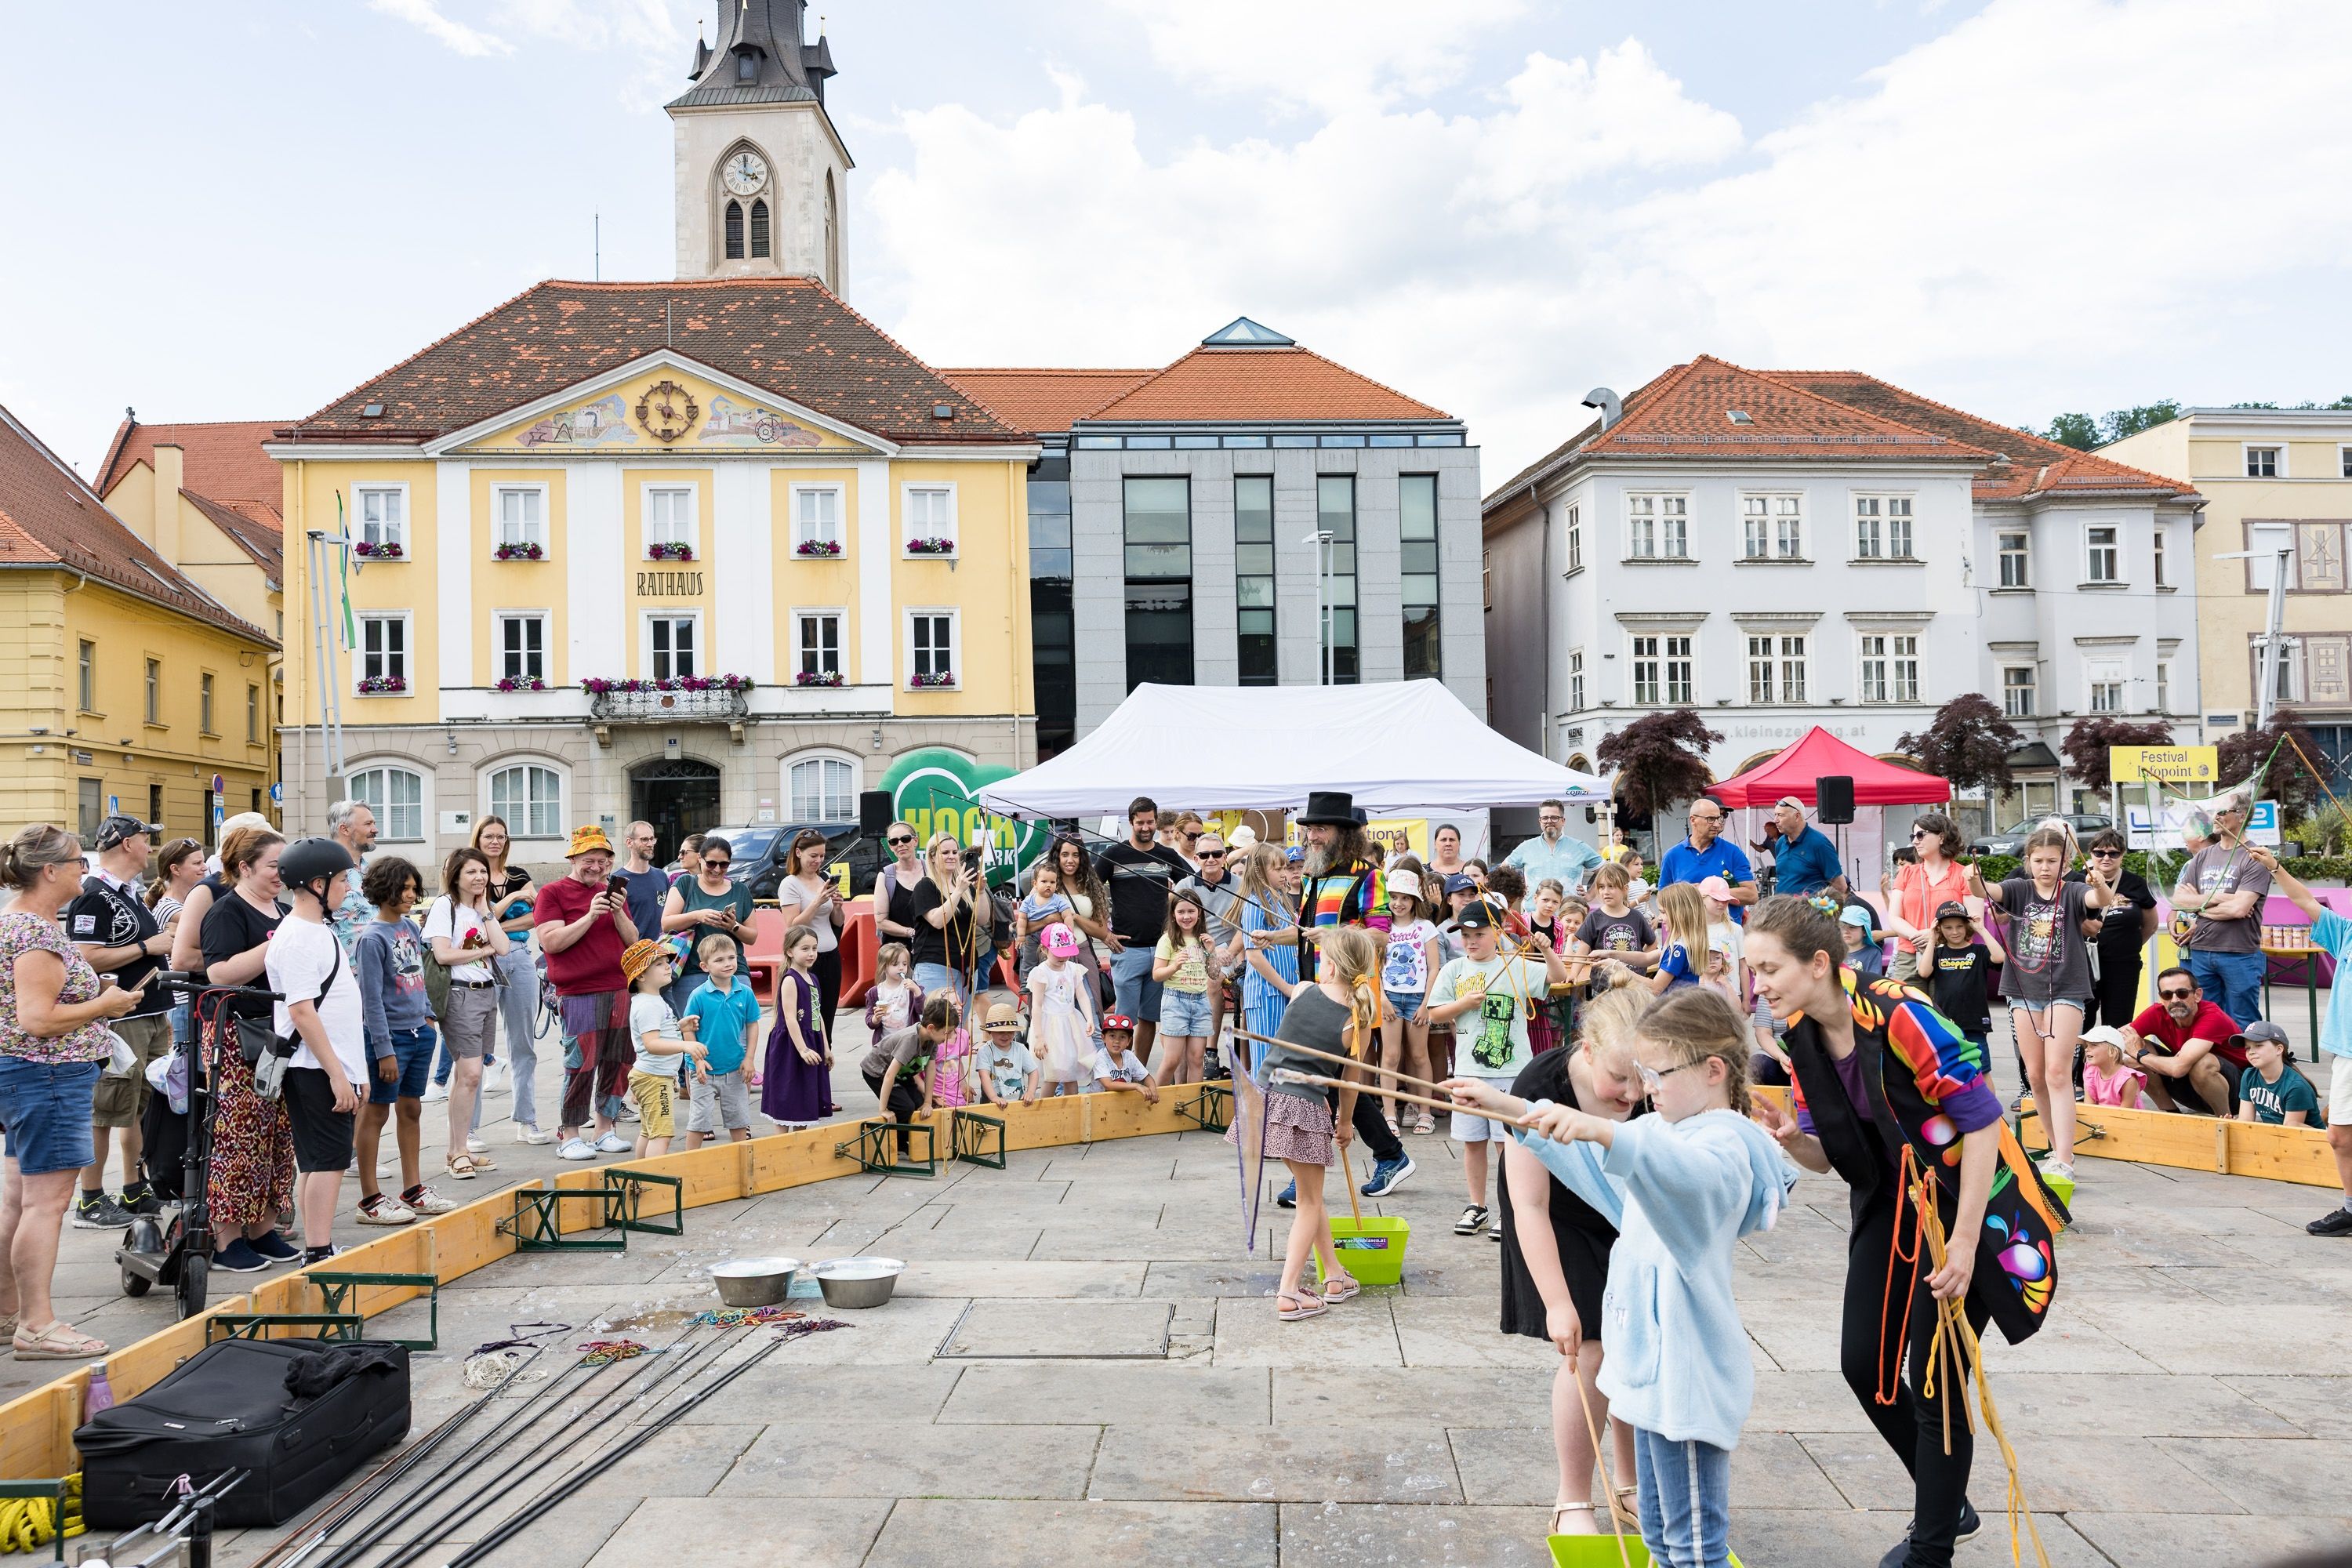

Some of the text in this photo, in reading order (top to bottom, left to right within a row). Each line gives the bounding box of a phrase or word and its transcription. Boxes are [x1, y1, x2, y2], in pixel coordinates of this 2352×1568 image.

[637, 572, 703, 596] RATHAUS
[2141, 750, 2187, 763] Festival
[2137, 765, 2192, 778] Ifopoint
[1388, 929, 1420, 944] Stitch
[2249, 1087, 2285, 1115] PUMA
